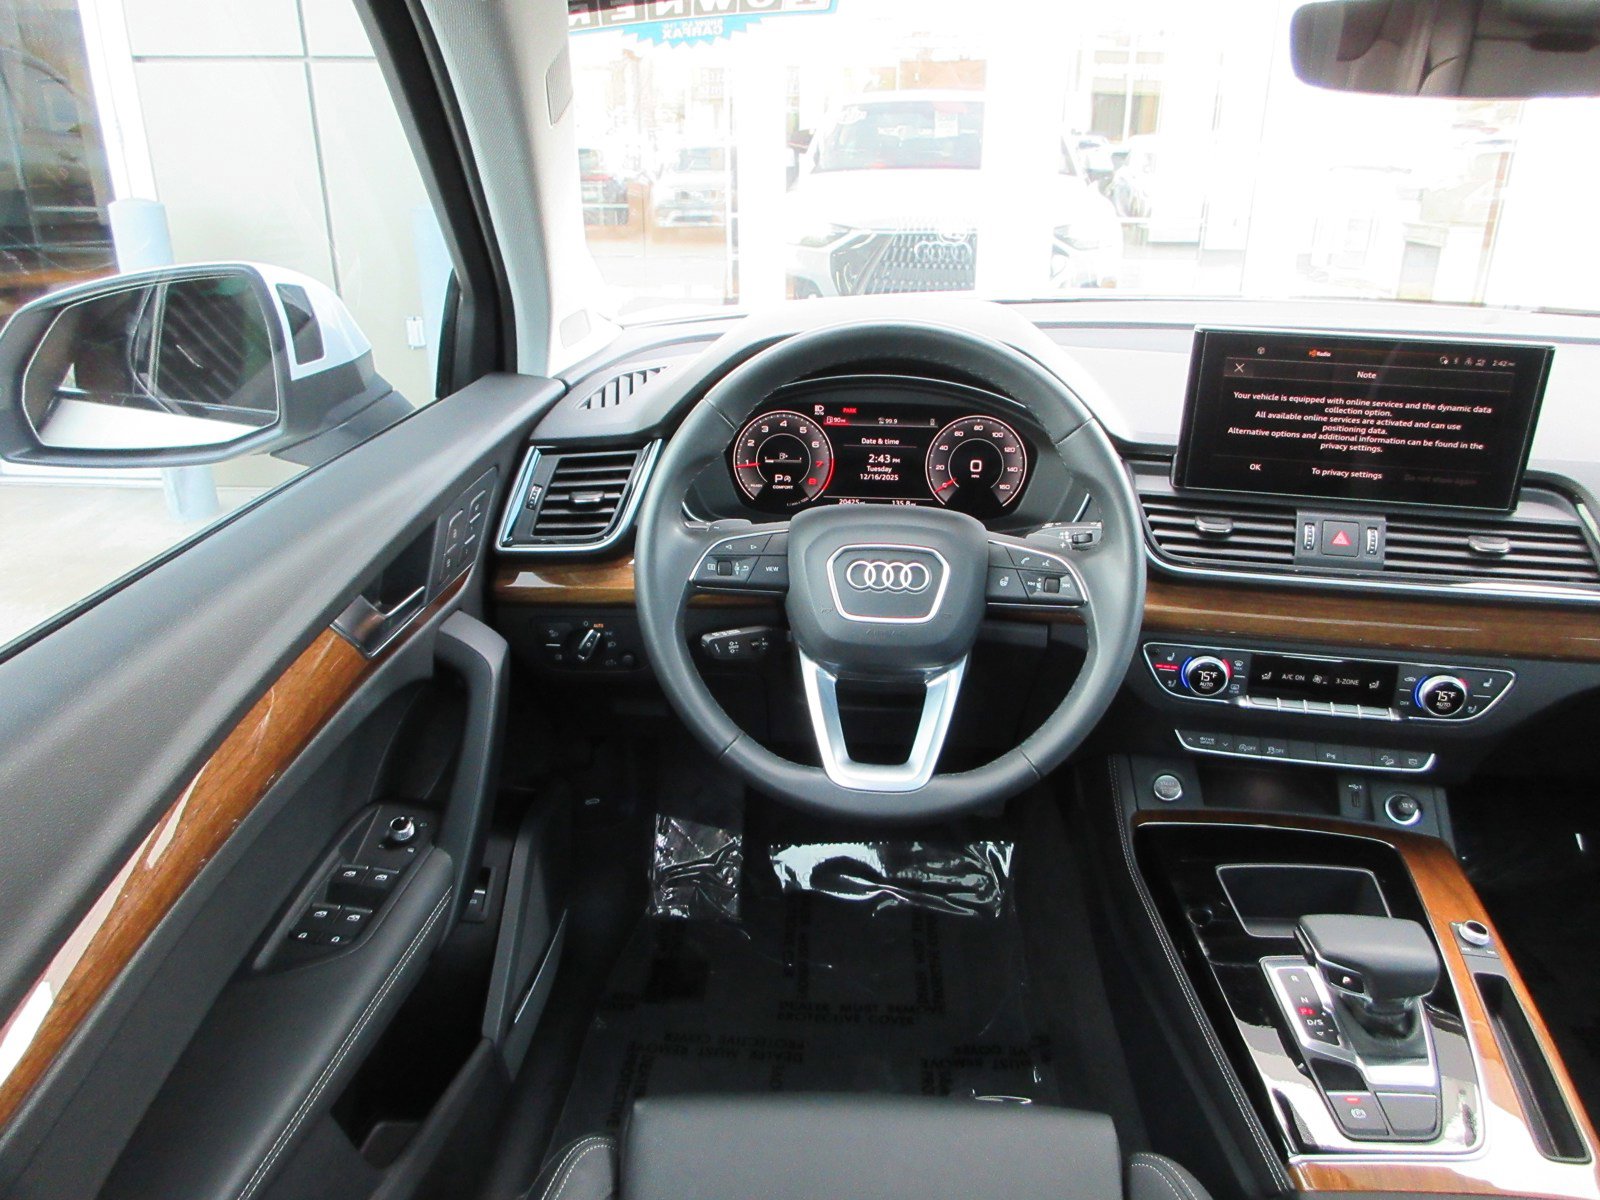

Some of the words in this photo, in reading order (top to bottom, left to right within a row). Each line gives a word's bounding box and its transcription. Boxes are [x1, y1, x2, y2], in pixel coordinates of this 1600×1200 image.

[1356, 371, 1377, 380] Note
[1233, 391, 1251, 400] Your
[1252, 393, 1279, 401] vehicle
[1289, 395, 1325, 405] equipped
[1327, 396, 1344, 405] with
[1346, 398, 1371, 407] online
[1372, 400, 1404, 409] services
[1405, 402, 1420, 410] and
[1422, 402, 1436, 411] the
[1437, 404, 1471, 414] dynamic
[1473, 405, 1492, 414] data
[1325, 407, 1363, 415] collection
[1364, 409, 1393, 419] option.
[1255, 411, 1266, 419] All
[1268, 411, 1302, 421] available
[1303, 414, 1328, 422] online
[1329, 416, 1361, 424] services
[1376, 419, 1412, 428] activated
[1414, 421, 1430, 429] and
[761, 425, 769, 433] 3
[799, 426, 808, 434] 5
[1322, 425, 1366, 435] positioning
[1368, 427, 1388, 435] data.
[747, 439, 755, 447] 2
[884, 438, 900, 446] time
[1228, 427, 1269, 437] Alternative
[1271, 429, 1300, 439] options
[1302, 431, 1316, 439] and
[1318, 433, 1358, 442] additional
[1359, 435, 1406, 445] information
[1423, 439, 1433, 447] be
[1435, 440, 1459, 449] found
[1469, 442, 1484, 450] the
[1320, 443, 1348, 452] privacy
[1349, 444, 1383, 454] settings.
[868, 453, 891, 463] 2:43
[816, 460, 824, 468] 7
[970, 459, 982, 472] 0
[1249, 463, 1261, 471] OK
[866, 465, 892, 473] Tuesday
[1312, 467, 1320, 475] To
[1322, 468, 1349, 478] privacy
[1350, 471, 1383, 480] settings
[859, 473, 899, 481] 12/16/2025
[1281, 673, 1293, 681] A/C
[1294, 674, 1306, 682] ON
[1335, 677, 1360, 686] 3-ZONE
[1342, 976, 1352, 984] P
[1300, 996, 1309, 1004] N
[1306, 1018, 1324, 1027] D/S
